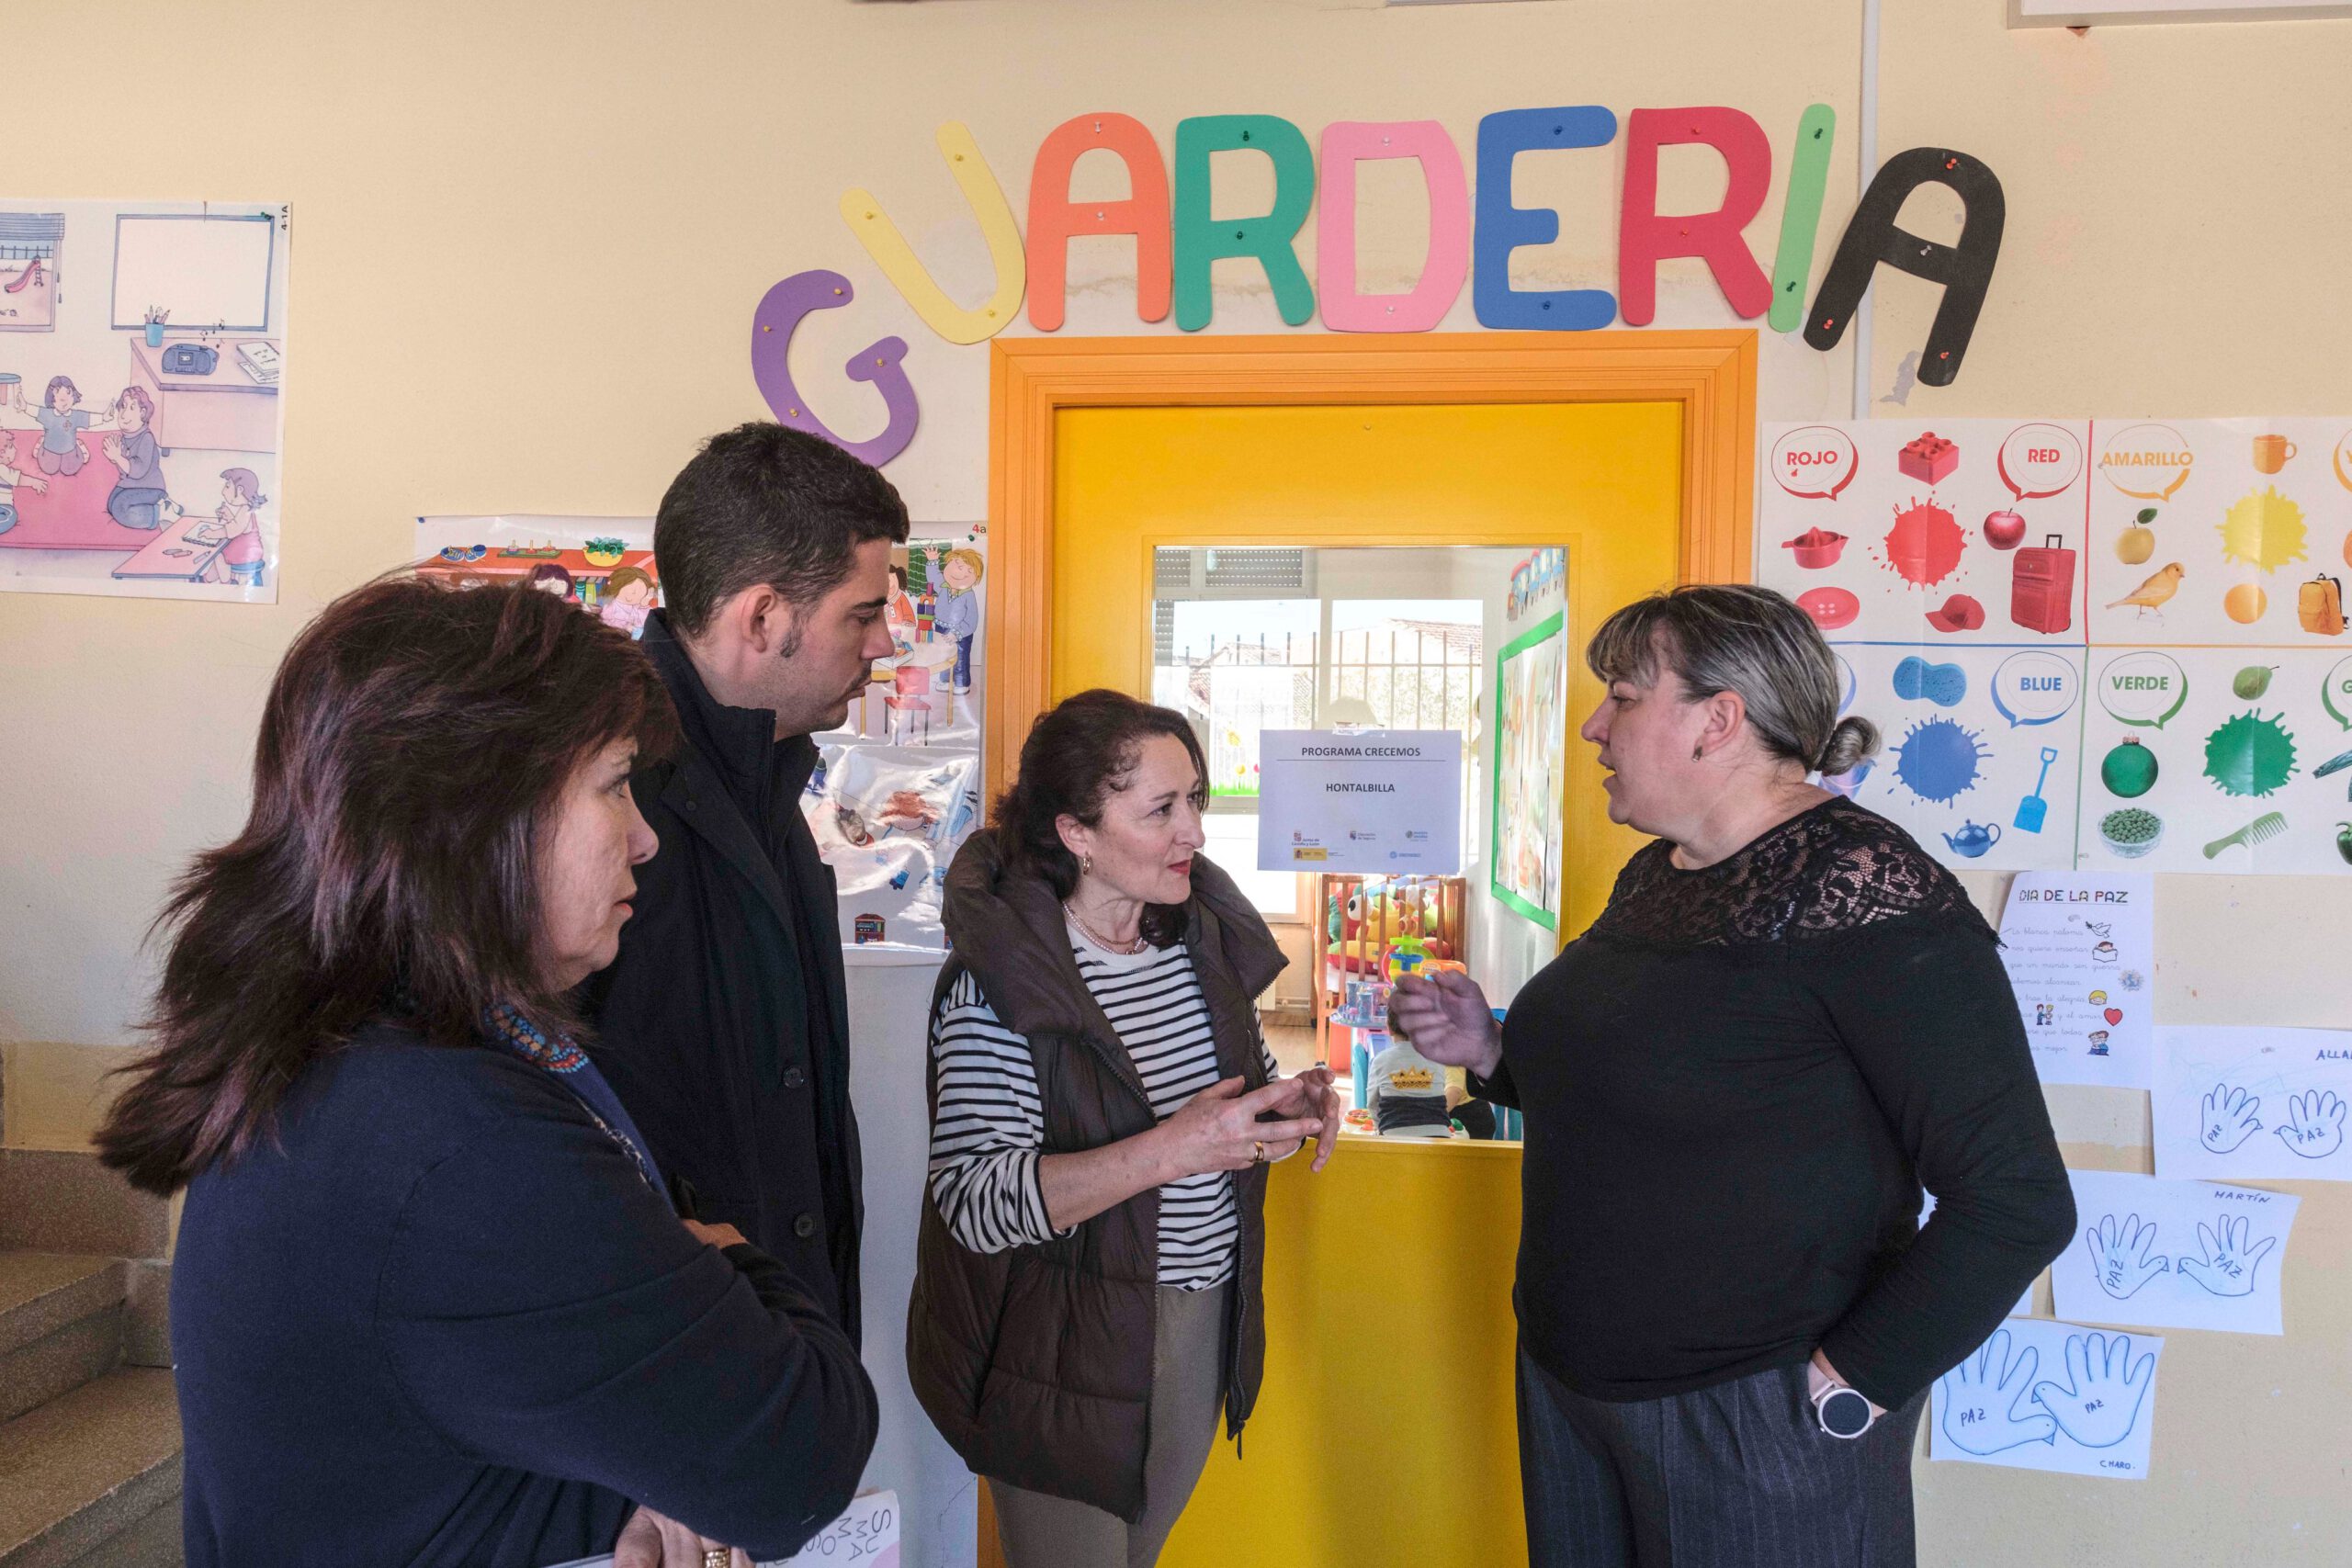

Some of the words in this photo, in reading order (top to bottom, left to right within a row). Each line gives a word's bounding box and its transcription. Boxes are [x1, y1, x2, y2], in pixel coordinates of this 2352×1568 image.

[751, 103, 2006, 468] GUARDERIA
[1786, 449, 1838, 466] ROJO
[2027, 448, 2061, 463] RED
[2101, 451, 2194, 467] AMARILLO
[2020, 676, 2063, 691] BLUE
[2112, 675, 2169, 691] VERDE
[1301, 747, 1363, 757] PROGRAMA
[1364, 747, 1421, 757] CRECEMOS
[1326, 783, 1396, 793] HONTALBILLA
[2018, 889, 2039, 902] DIA
[2044, 889, 2064, 902] DE
[2069, 890, 2088, 902] LA
[2095, 891, 2129, 904] PAZ
[2315, 1049, 2352, 1061] ALLA
[2207, 1123, 2223, 1143] PAZ
[2298, 1127, 2325, 1145] PAZ
[2212, 1252, 2244, 1280] PAZ
[2106, 1258, 2124, 1291] PAZ
[2084, 1399, 2105, 1414] PAZ
[1960, 1408, 1987, 1427] PAZ
